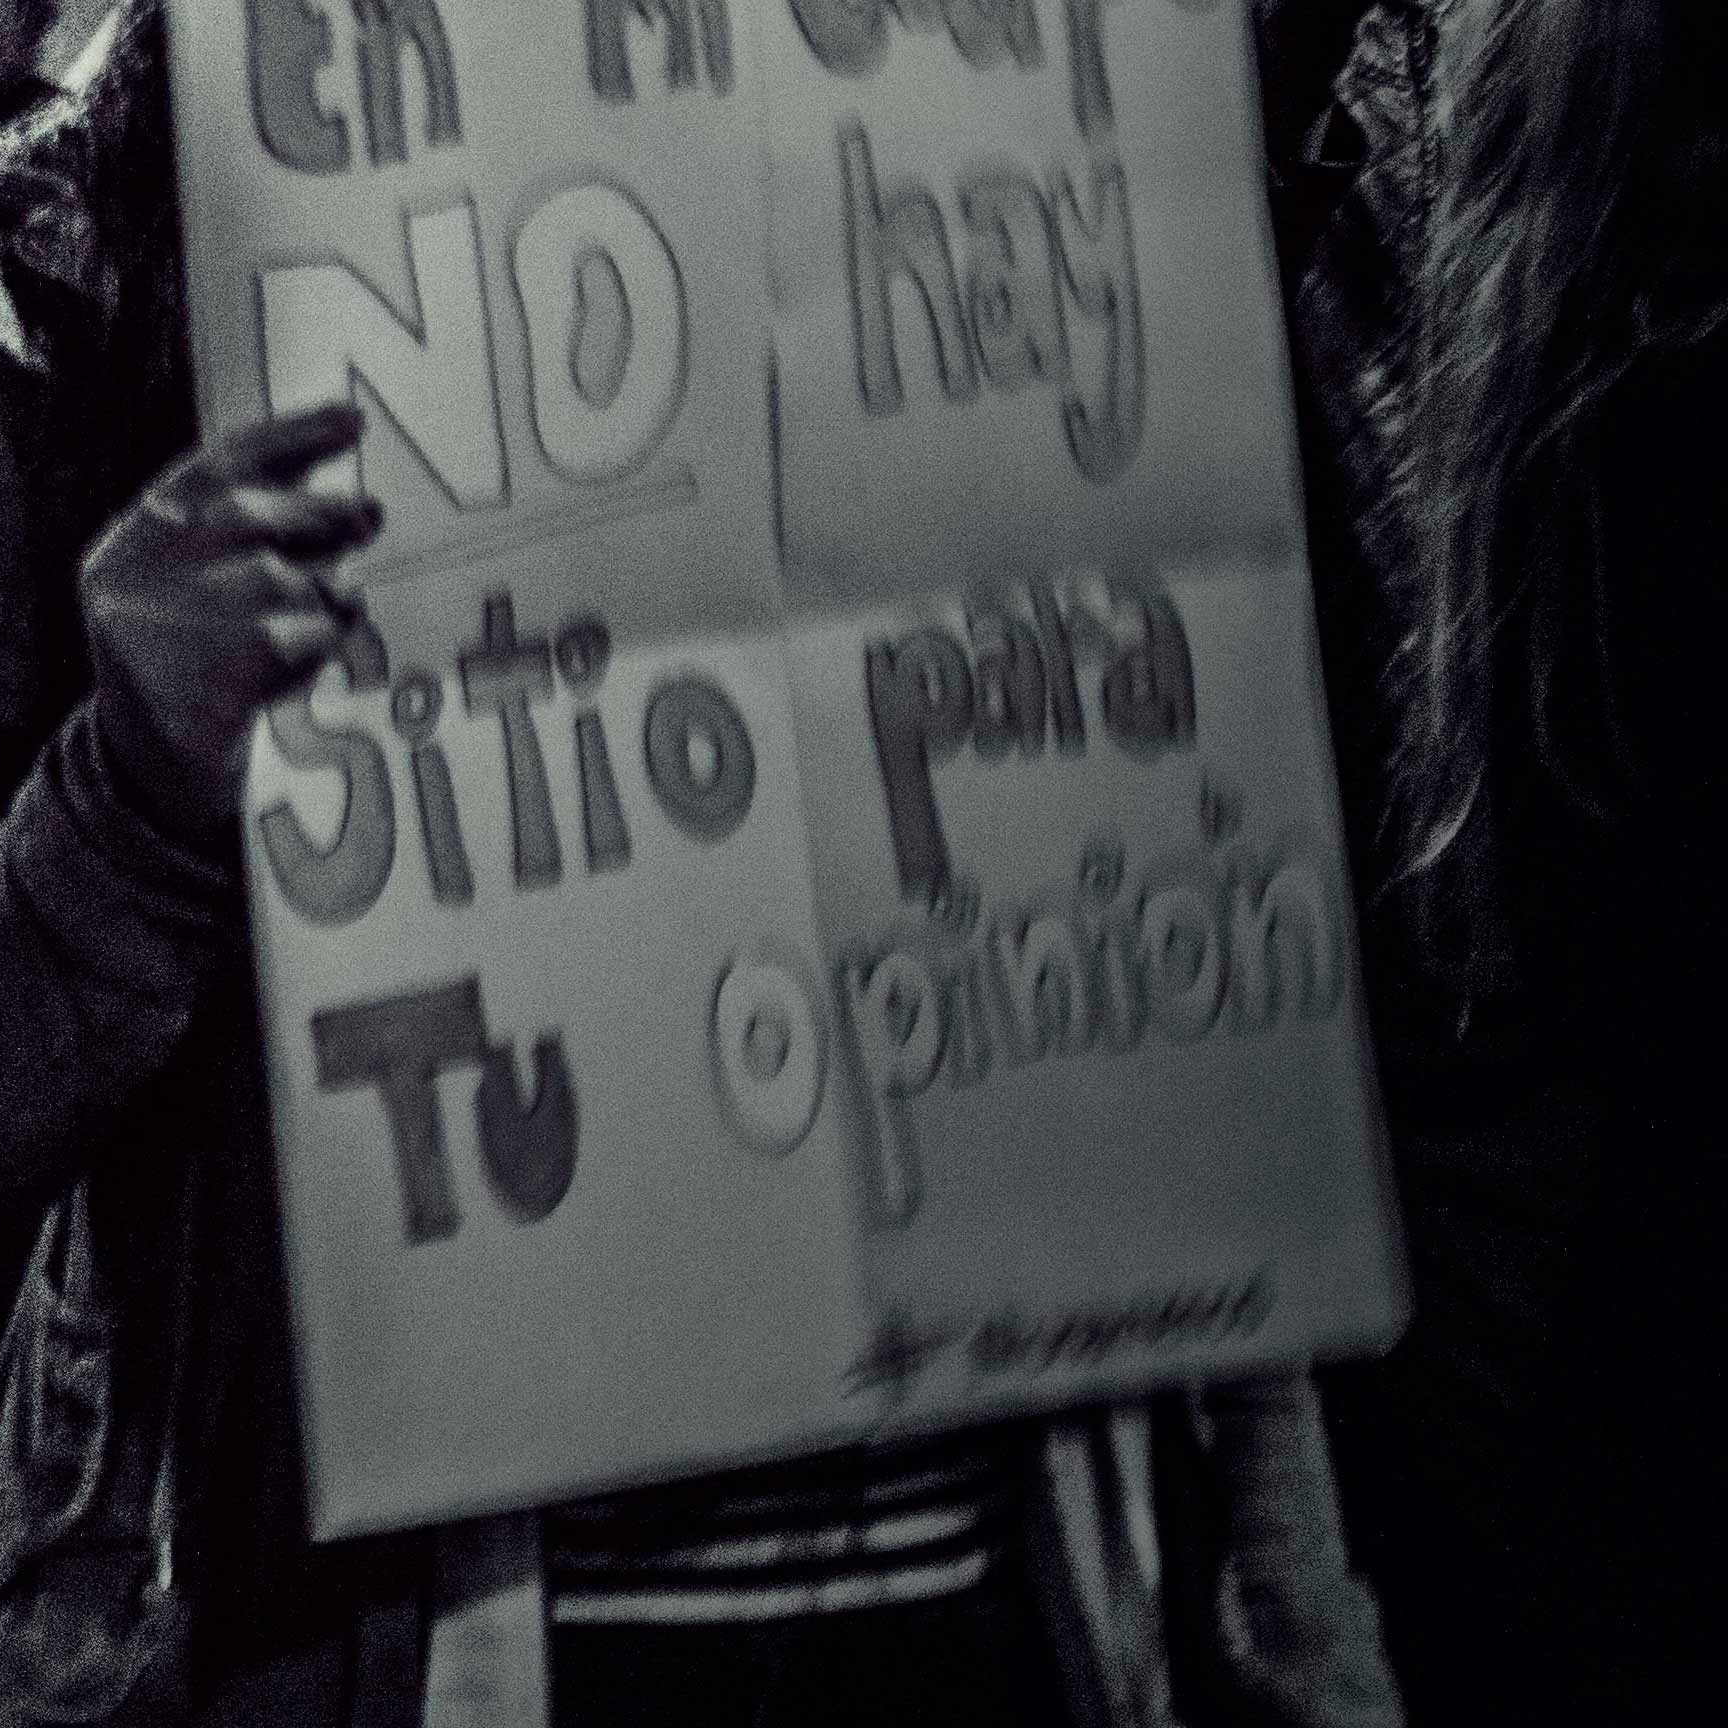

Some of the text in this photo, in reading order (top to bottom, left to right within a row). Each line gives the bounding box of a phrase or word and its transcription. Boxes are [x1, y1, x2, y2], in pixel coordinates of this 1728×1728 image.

[252, 110, 1148, 514] NO hay
[258, 564, 1198, 929] Sitio para
